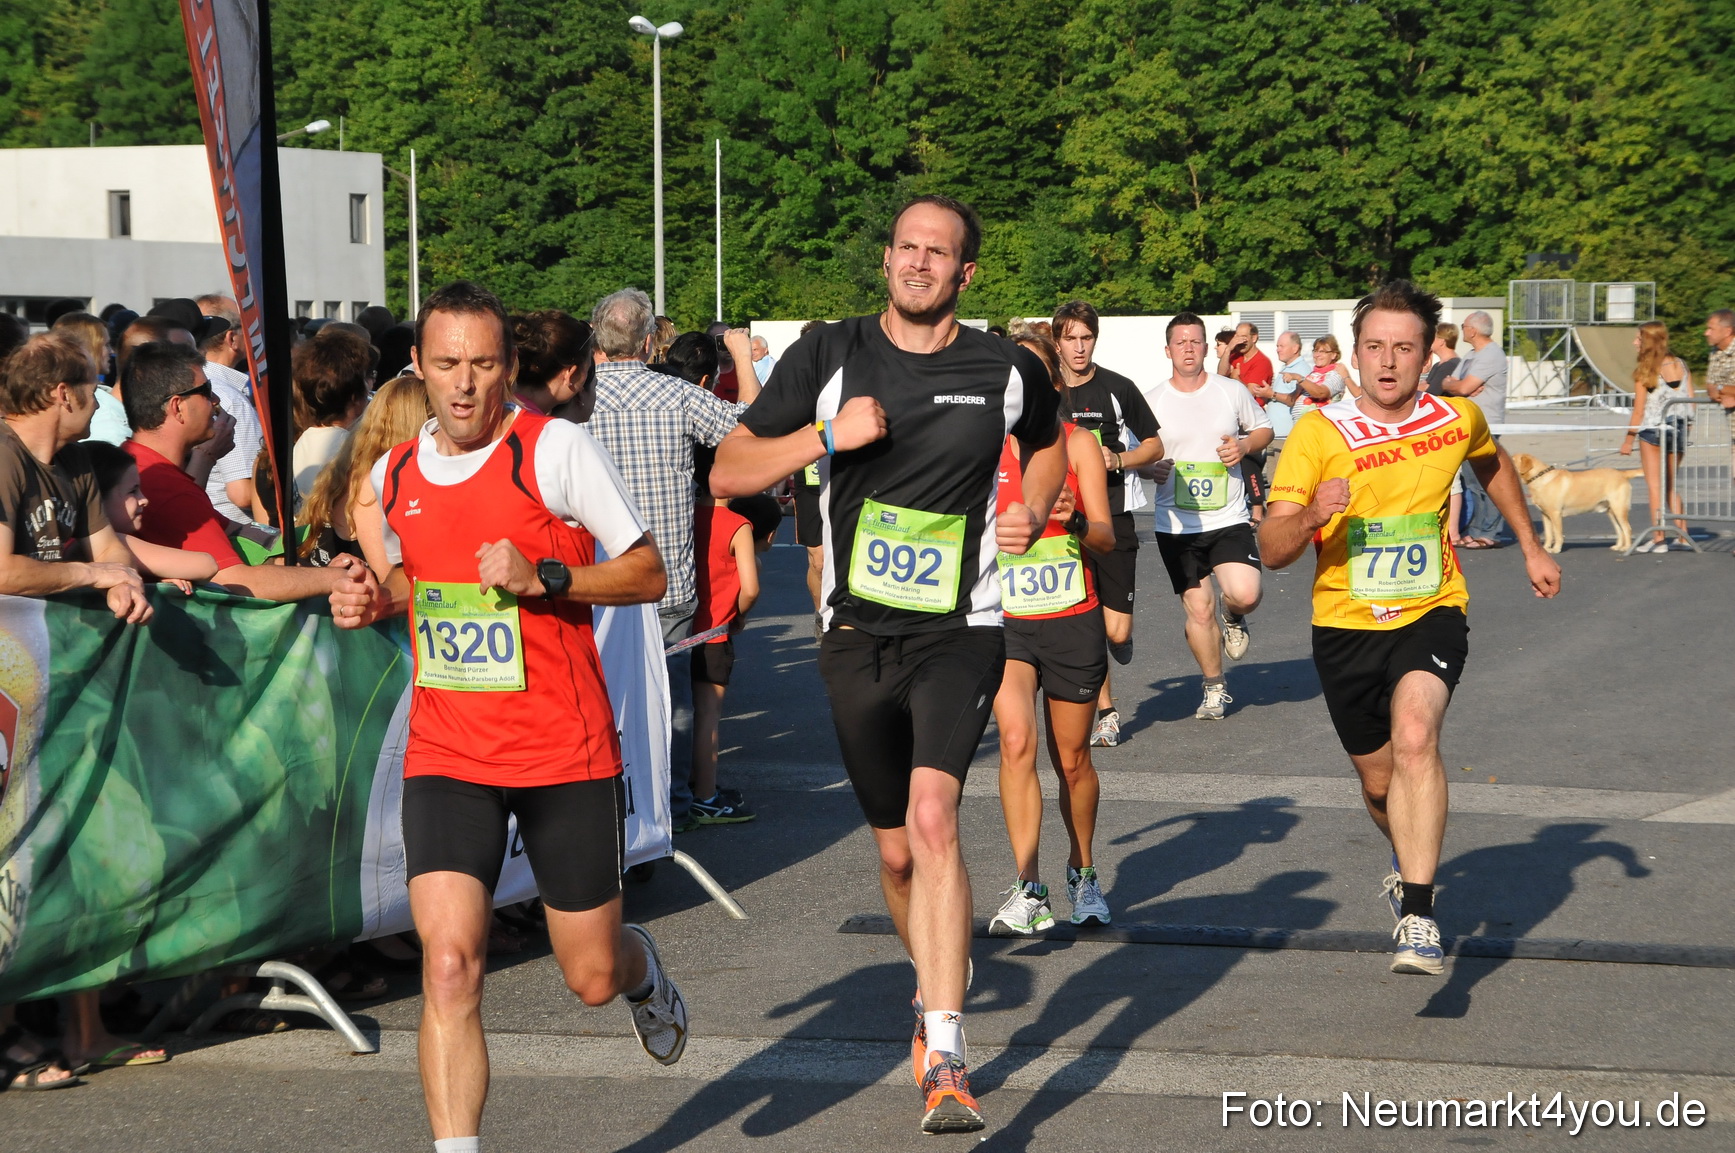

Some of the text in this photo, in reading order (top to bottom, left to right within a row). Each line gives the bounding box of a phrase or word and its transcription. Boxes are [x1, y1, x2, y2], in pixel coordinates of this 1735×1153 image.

[942, 395, 986, 405] PFLEIDERER
[1354, 426, 1470, 473] MAX BÖGL
[1188, 478, 1213, 498] 69
[866, 538, 943, 587] 992
[1361, 543, 1428, 579] 779
[1002, 561, 1077, 597] 1307
[882, 581, 921, 594] Martin Häring
[420, 600, 457, 609] firmenlauf
[885, 591, 923, 602] Holzwerkstoffe
[418, 618, 515, 664] 1320
[444, 664, 467, 673] Bernhard
[424, 671, 448, 680] Sparkasse
[448, 674, 498, 683] Neumarkt-Parsberg
